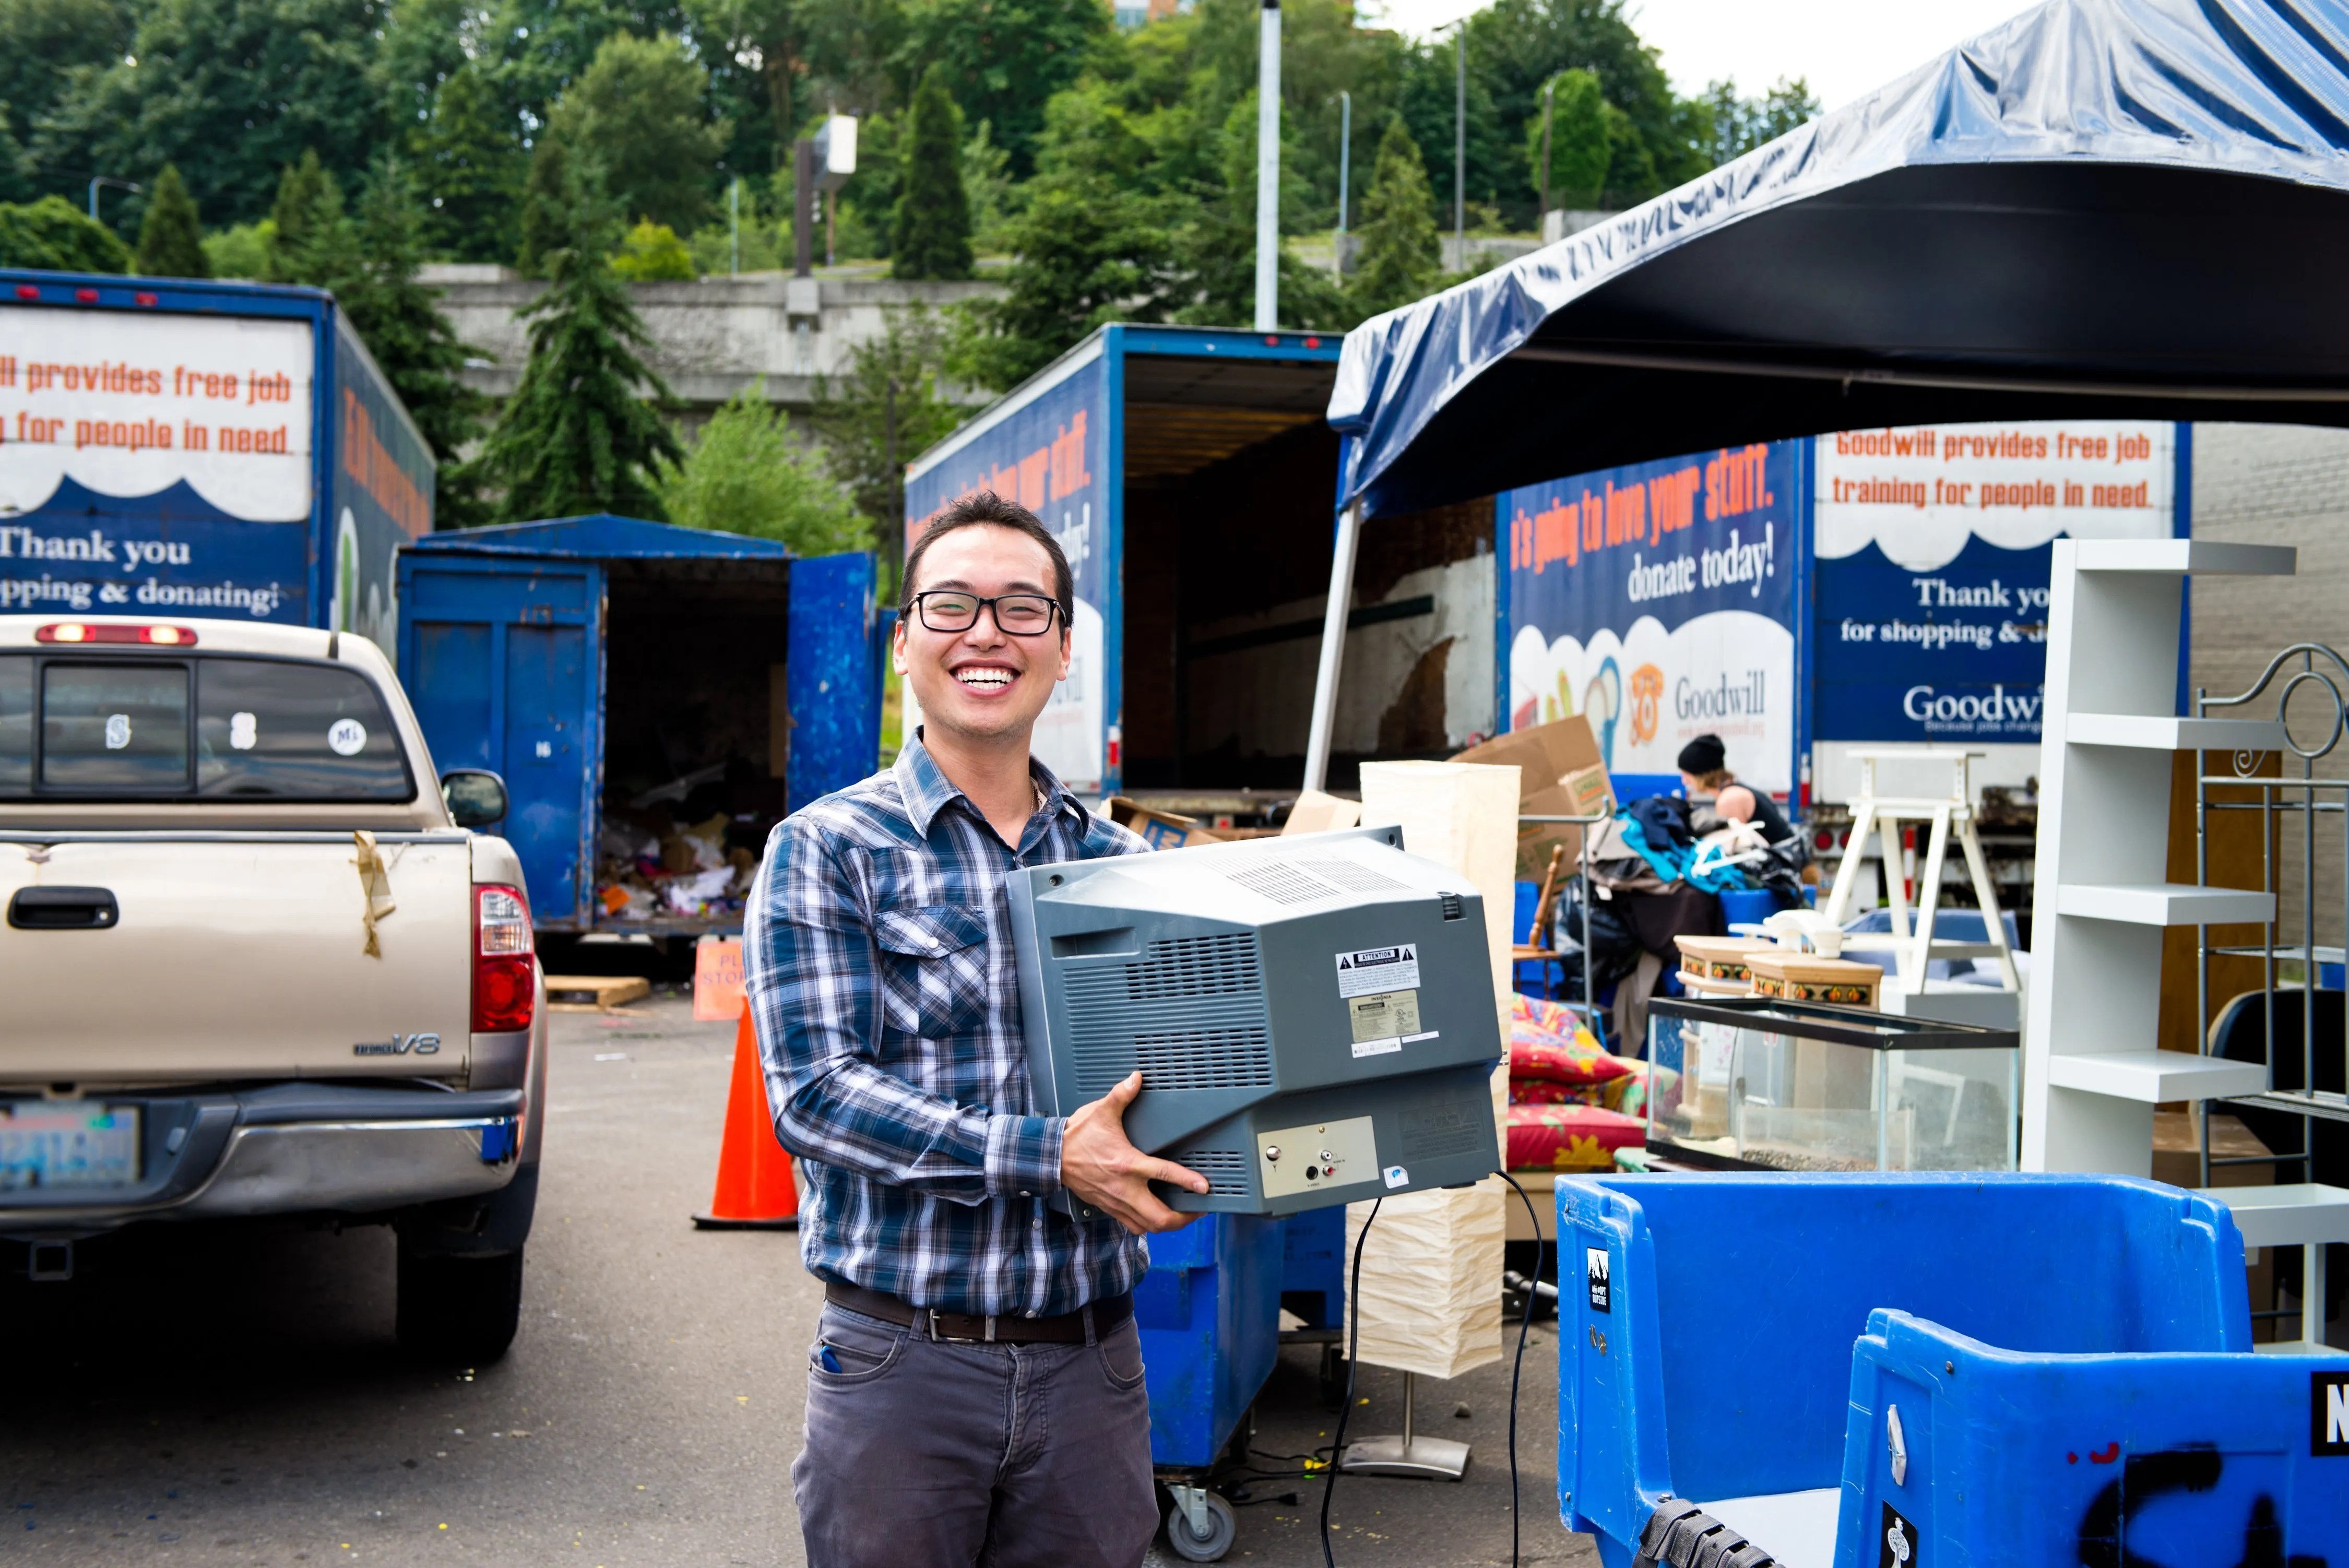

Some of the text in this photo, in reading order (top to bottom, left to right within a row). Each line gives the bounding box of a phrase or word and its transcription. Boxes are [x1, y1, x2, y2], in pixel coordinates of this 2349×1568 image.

[28, 360, 162, 395] provides
[174, 365, 238, 399] free
[246, 370, 290, 406] job
[17, 410, 64, 443] for
[75, 417, 172, 453] people
[184, 419, 208, 450] in
[1837, 426, 2151, 465] Goodwill provides free job
[1582, 489, 1603, 553] to
[1606, 480, 1645, 548] love
[1649, 465, 1700, 548] your
[1705, 442, 1774, 522] stuff.
[1833, 476, 2153, 510] training for people in need.
[0, 526, 191, 573] Thank you
[1628, 520, 1774, 603] donate today!
[99, 583, 130, 604] &
[136, 577, 279, 617] donating!
[1912, 578, 2011, 608] Thank
[1841, 617, 1876, 642] for
[1880, 618, 1994, 651] shopping
[1998, 620, 2022, 643] &
[1676, 669, 1765, 721] Goodwill
[1362, 951, 1391, 961] ATTENTION
[393, 1033, 441, 1054] V8
[1592, 1293, 1607, 1306] OUTSIDE
